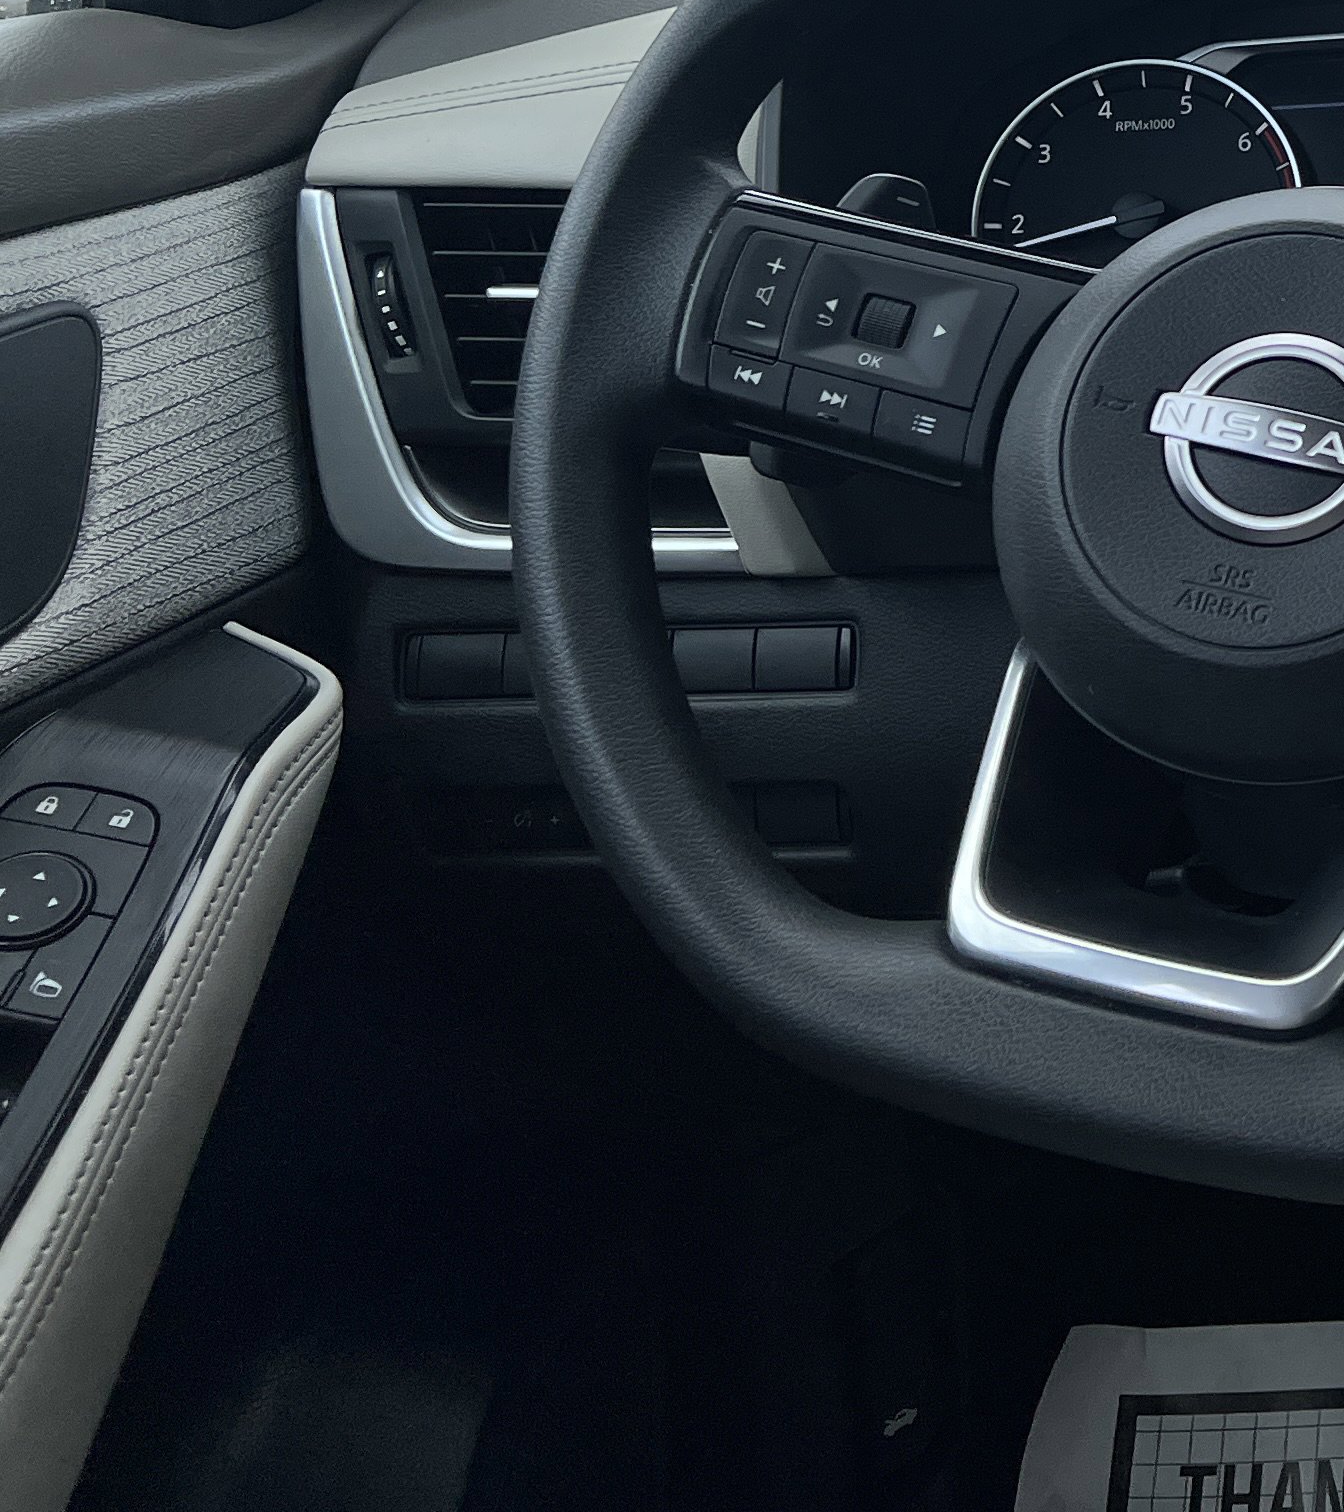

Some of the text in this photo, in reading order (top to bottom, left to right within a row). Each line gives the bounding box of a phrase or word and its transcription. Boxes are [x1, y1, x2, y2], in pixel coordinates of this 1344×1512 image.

[1097, 100, 1112, 119] 4
[1179, 95, 1193, 115] 5
[1115, 118, 1176, 132] RPMx1000
[1238, 133, 1251, 152] 6
[1038, 144, 1051, 164] 3
[1011, 214, 1025, 234] 2
[857, 352, 883, 370] OK
[1207, 563, 1256, 589] SRS
[1173, 590, 1275, 626] AIRBAG
